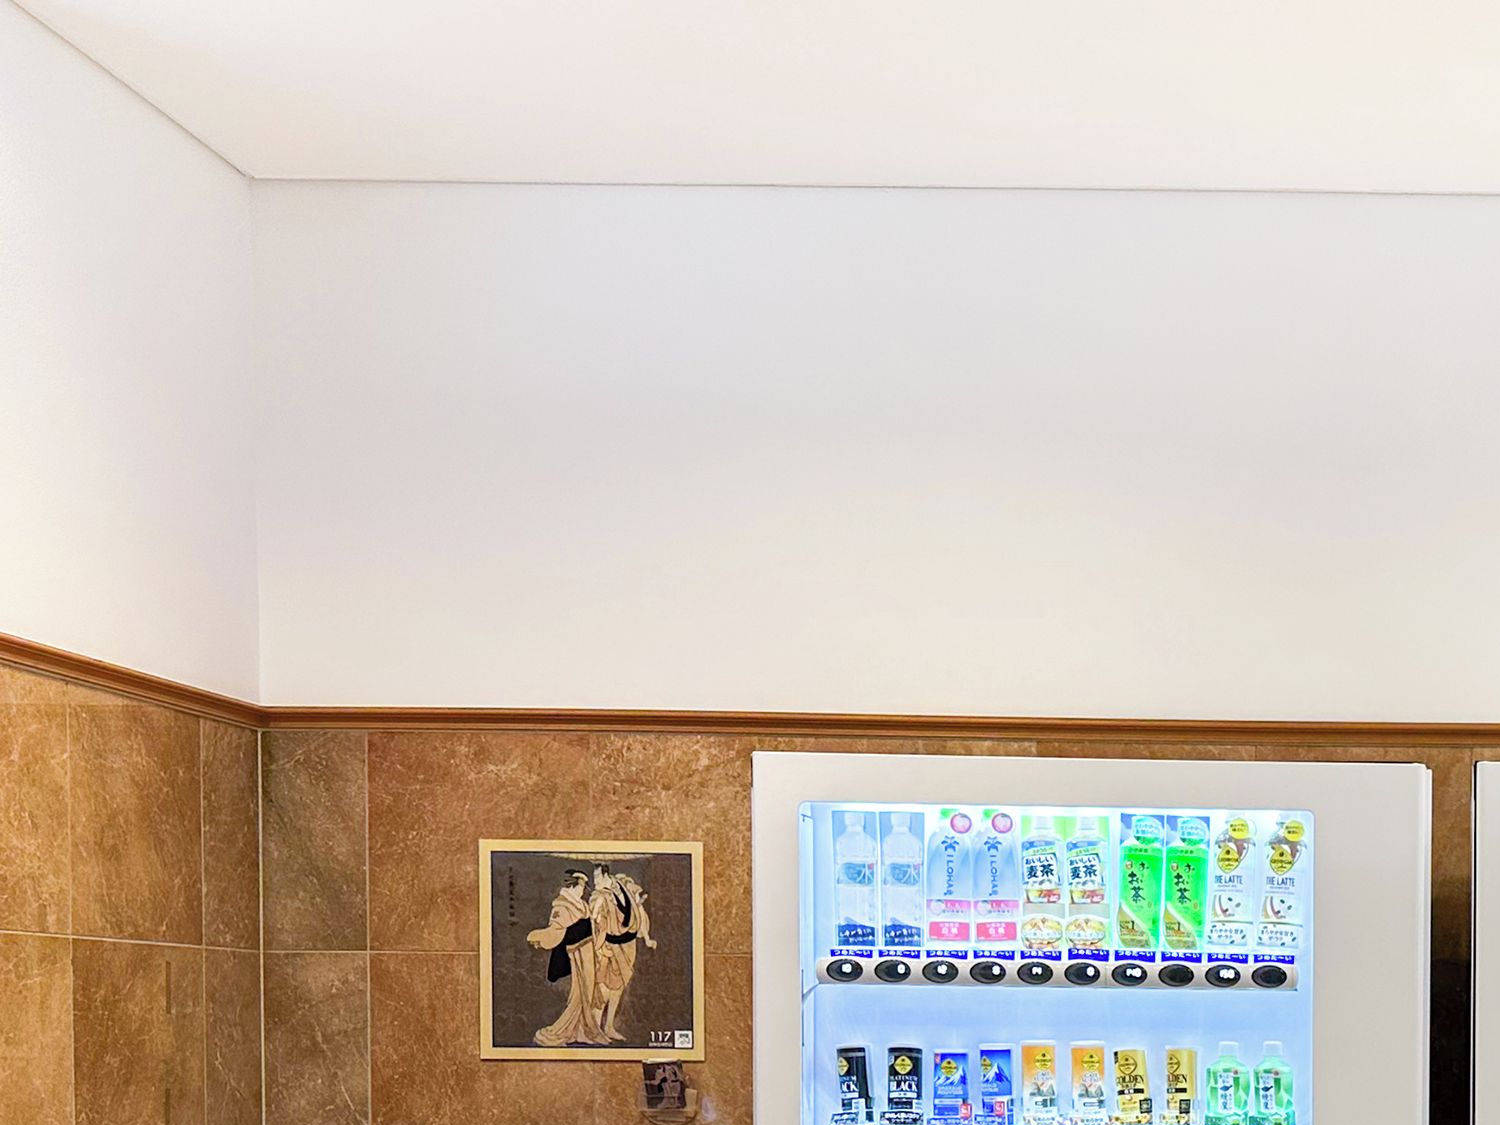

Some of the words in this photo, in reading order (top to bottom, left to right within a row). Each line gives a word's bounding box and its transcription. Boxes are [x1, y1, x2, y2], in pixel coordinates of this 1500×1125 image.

[1024, 856, 1054, 866] おいしい
[1069, 856, 1096, 866] おいしい
[1026, 864, 1055, 879] 麦茶
[1070, 864, 1098, 880] 麦茶
[1224, 875, 1243, 885] LATTE
[1277, 877, 1295, 887] LATTE
[650, 1031, 671, 1042] 117
[889, 1081, 918, 1091] BLACK
